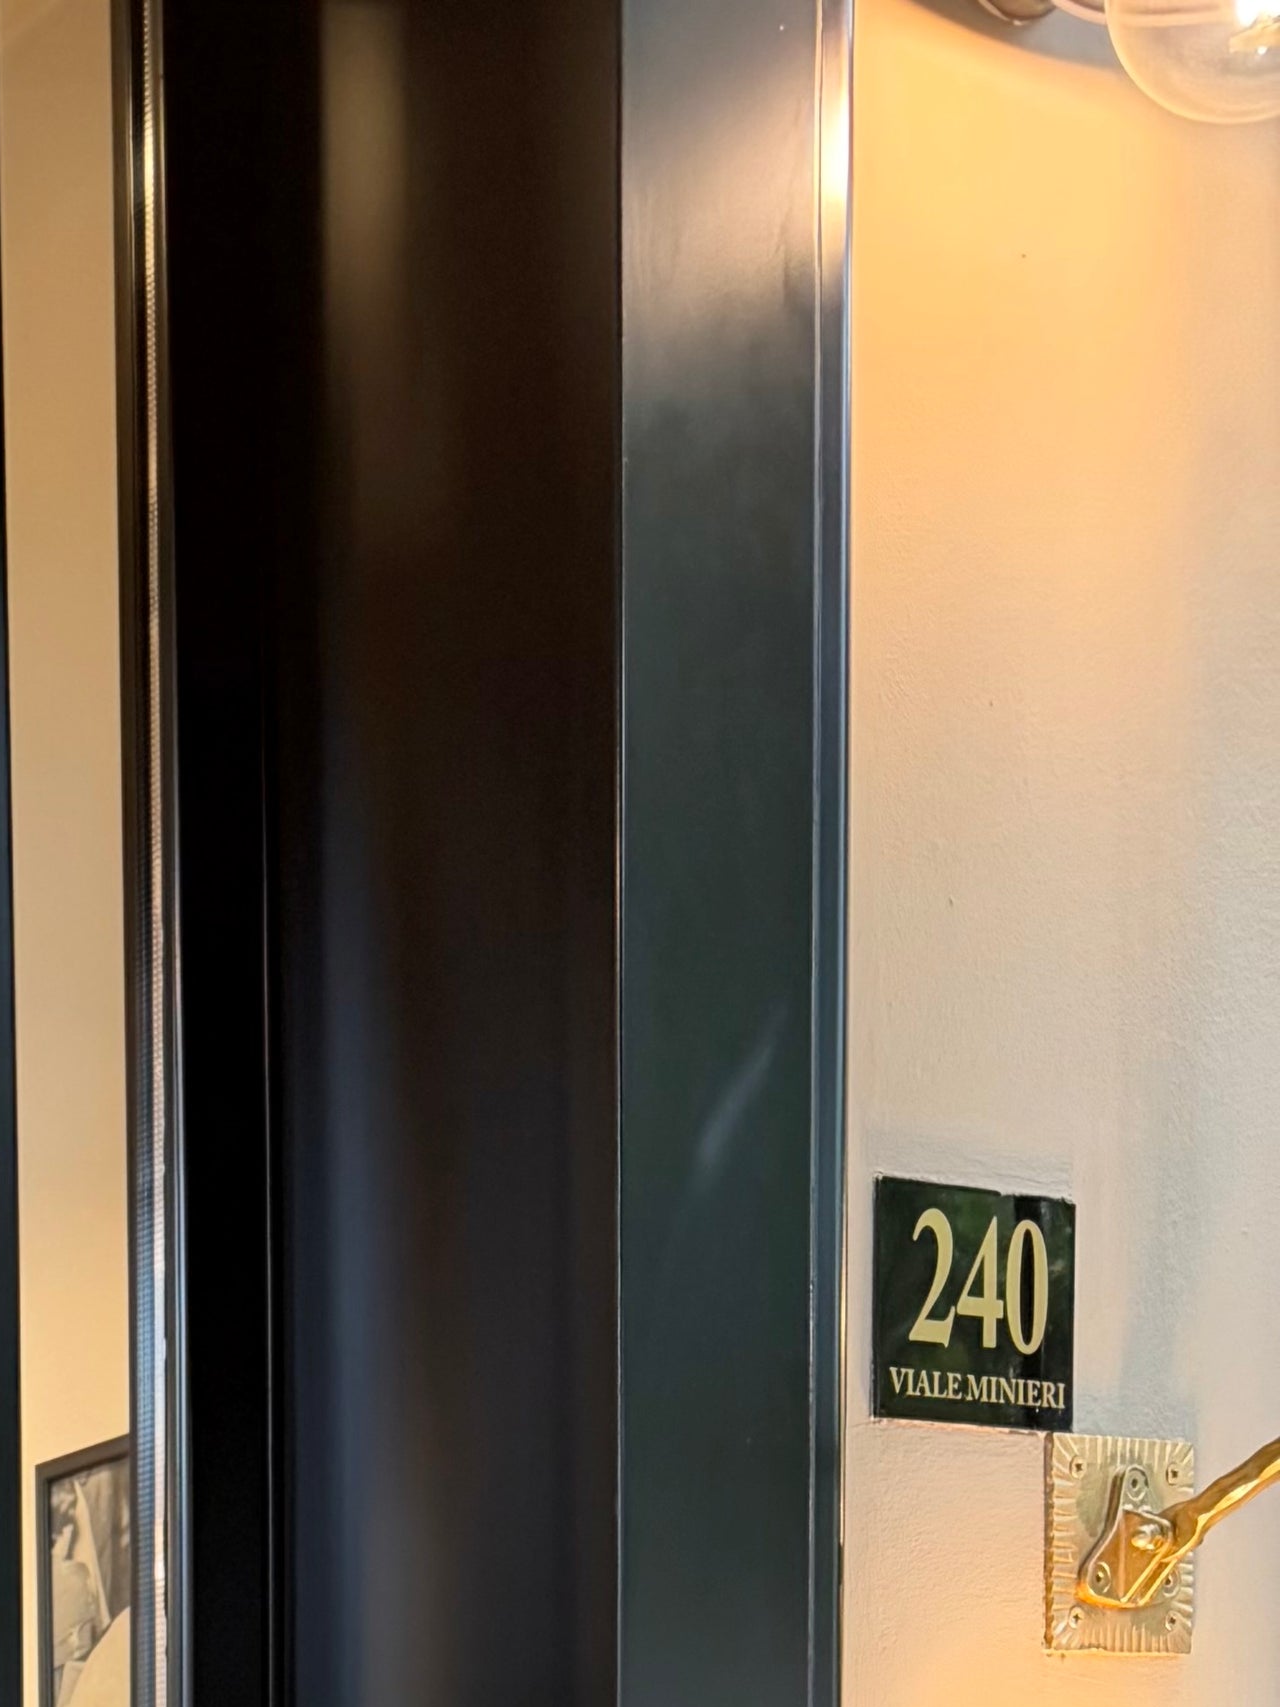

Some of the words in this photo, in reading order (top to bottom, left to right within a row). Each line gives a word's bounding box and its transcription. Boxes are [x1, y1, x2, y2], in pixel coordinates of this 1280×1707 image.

[909, 1208, 1049, 1355] 240
[889, 1366, 962, 1400] VIALE
[966, 1374, 1066, 1410] MINIERI
